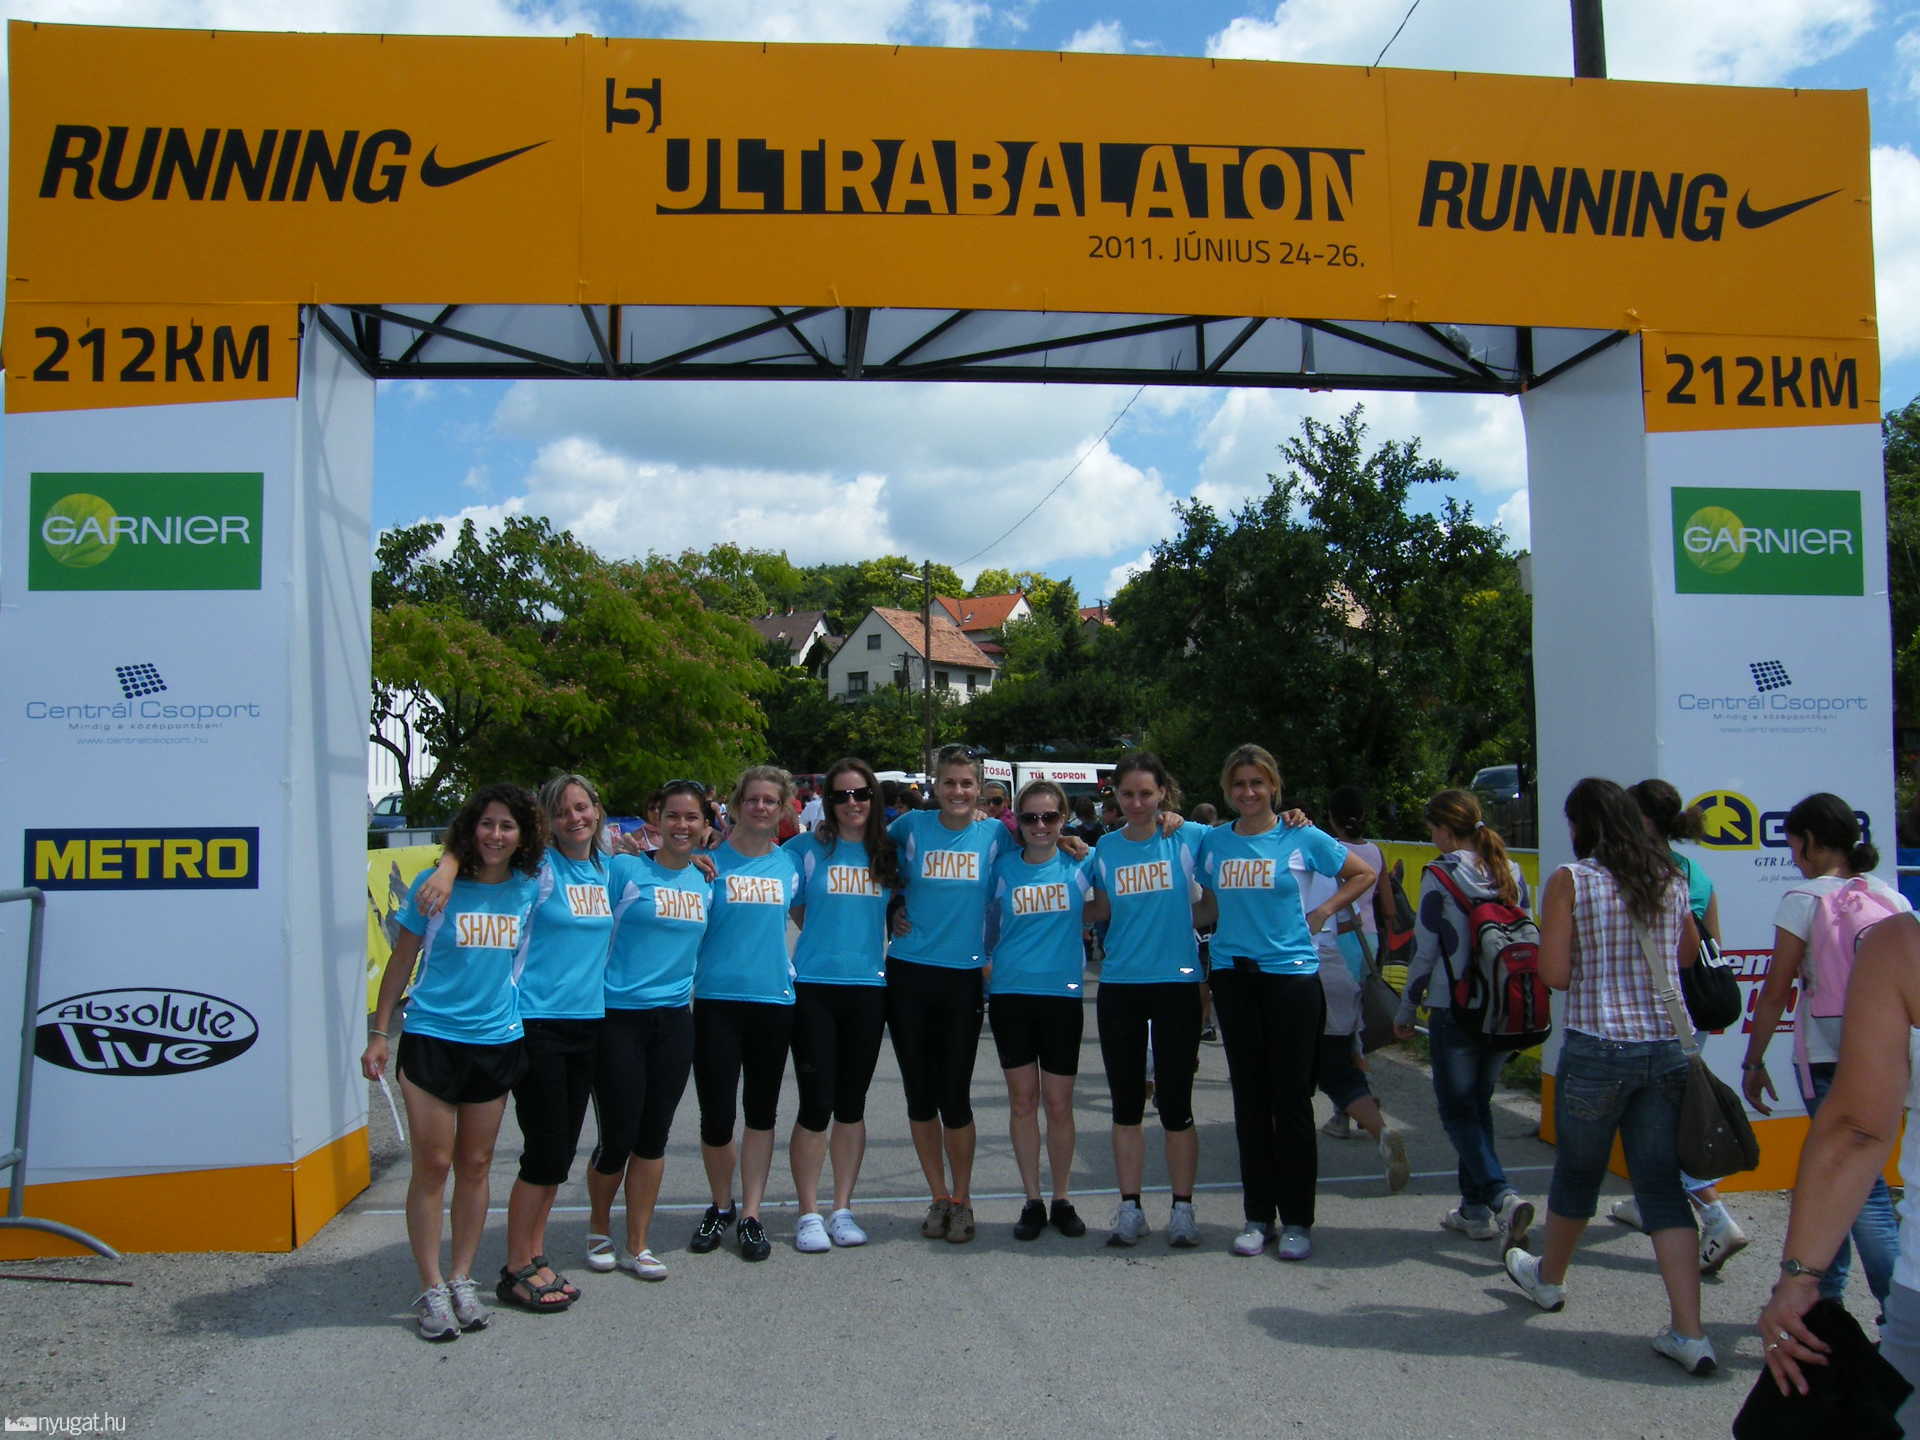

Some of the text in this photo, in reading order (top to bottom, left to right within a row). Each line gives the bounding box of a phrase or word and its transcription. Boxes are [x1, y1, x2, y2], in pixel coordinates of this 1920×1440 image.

[39, 124, 412, 204] RUNNING
[656, 138, 1366, 222] ULTRABALATON
[1418, 159, 1728, 242] RUNNING
[1088, 230, 1366, 268] 2011. JÚNIUS 24-26.
[33, 325, 270, 383] 212KM
[1665, 354, 1860, 409] 212KM
[26, 700, 261, 722] Centrál Csoport
[1678, 693, 1868, 713] Centrál Csoport
[1052, 771, 1087, 781] SOPRON
[35, 838, 249, 880] METRO
[925, 851, 977, 879] SHAPE
[1221, 859, 1273, 888] SHAPE
[1754, 856, 1778, 867] GTR
[729, 875, 783, 904] SHAPE
[1117, 862, 1170, 895] SHAPE
[568, 885, 612, 916] SHAPE
[656, 889, 705, 921] SHAPE
[1013, 883, 1068, 915] SHAPE
[458, 915, 518, 948] SHAPE
[58, 1023, 213, 1070] Live
